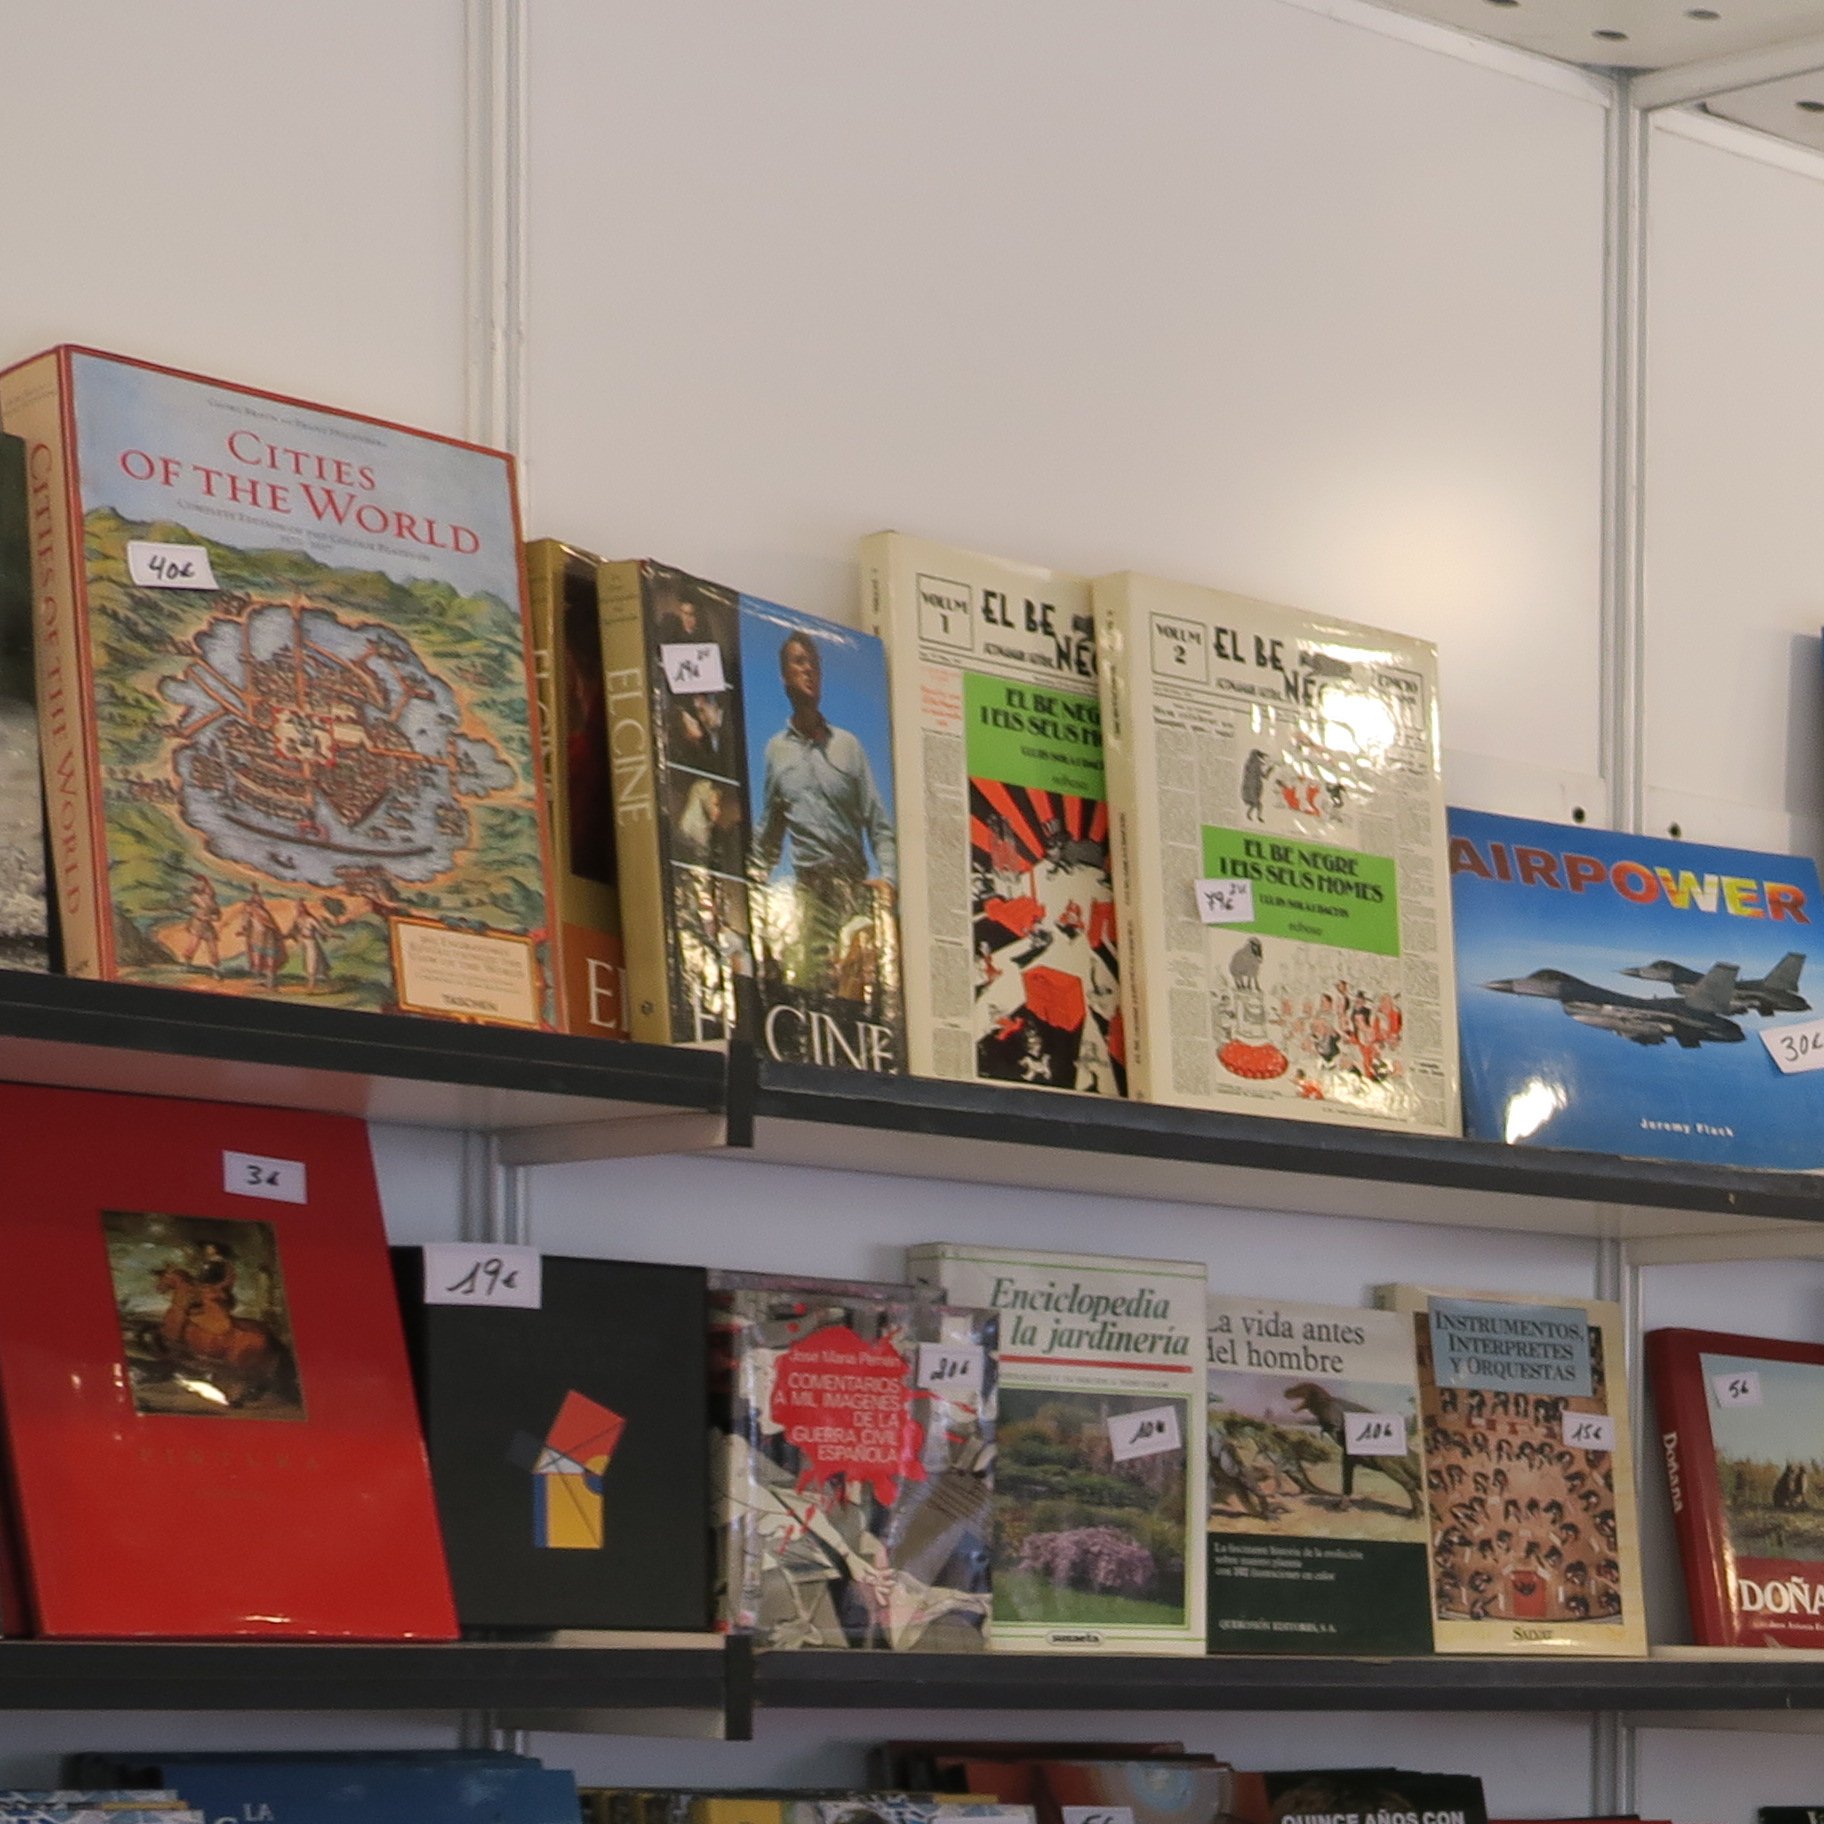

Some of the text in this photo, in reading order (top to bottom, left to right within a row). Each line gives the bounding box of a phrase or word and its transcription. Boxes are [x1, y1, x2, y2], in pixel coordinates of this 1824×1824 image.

[119, 448, 194, 485] OF
[192, 464, 293, 517] THE
[147, 551, 196, 583] 40€
[981, 590, 1056, 637] EL BE
[1214, 626, 1284, 673] EL BE
[1245, 838, 1360, 880] EL BE NEGRE
[1231, 859, 1385, 904] ELS SEUS HOMES
[1449, 833, 1812, 927] AIRPOWER
[1779, 1027, 1824, 1062] 30€
[989, 1276, 1171, 1322] Enciclopedia
[1043, 1322, 1192, 1358] jardinería
[1242, 1311, 1365, 1346] vida antes
[1246, 1341, 1345, 1374] hombre
[1466, 1356, 1577, 1383] ORQUESTAS
[787, 1372, 901, 1396] COMENTARIOS
[852, 1410, 900, 1429] DE LA
[790, 1427, 900, 1448] GUERRA CIVIL
[816, 1442, 900, 1464] ESPAÑOLA
[243, 1802, 276, 1824] LA
